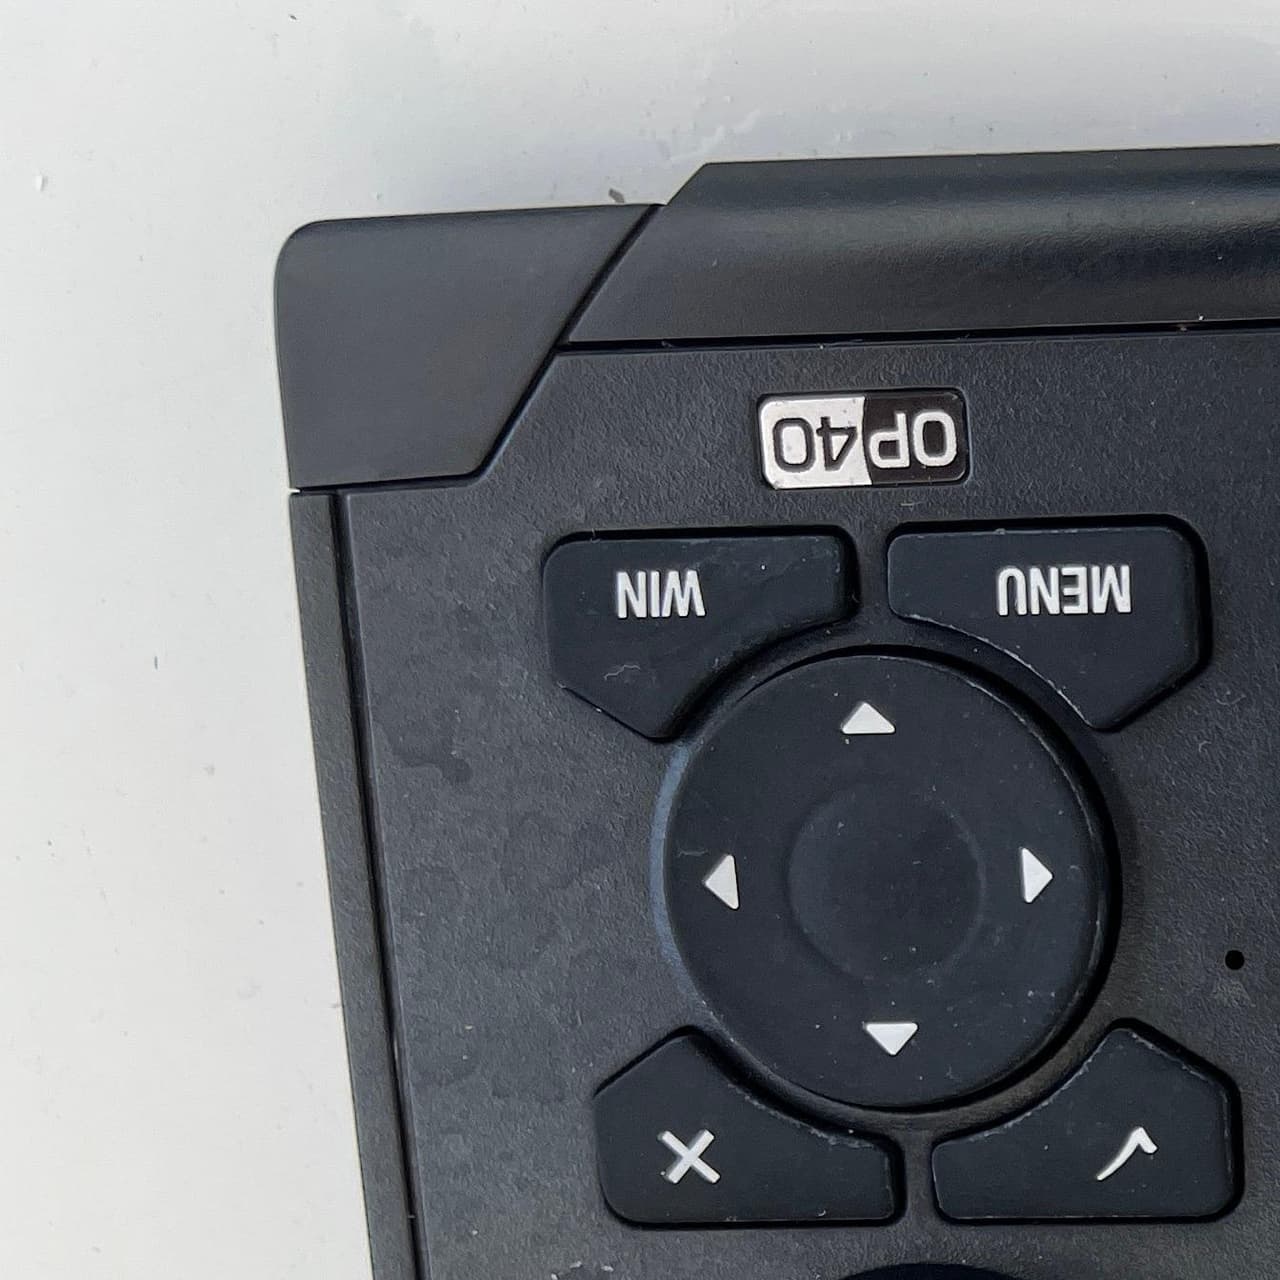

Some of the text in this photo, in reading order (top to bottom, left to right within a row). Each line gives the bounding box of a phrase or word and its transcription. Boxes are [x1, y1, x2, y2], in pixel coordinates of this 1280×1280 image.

[770, 408, 958, 477] OP40
[616, 569, 706, 619] WIN
[997, 564, 1132, 616] MENU
